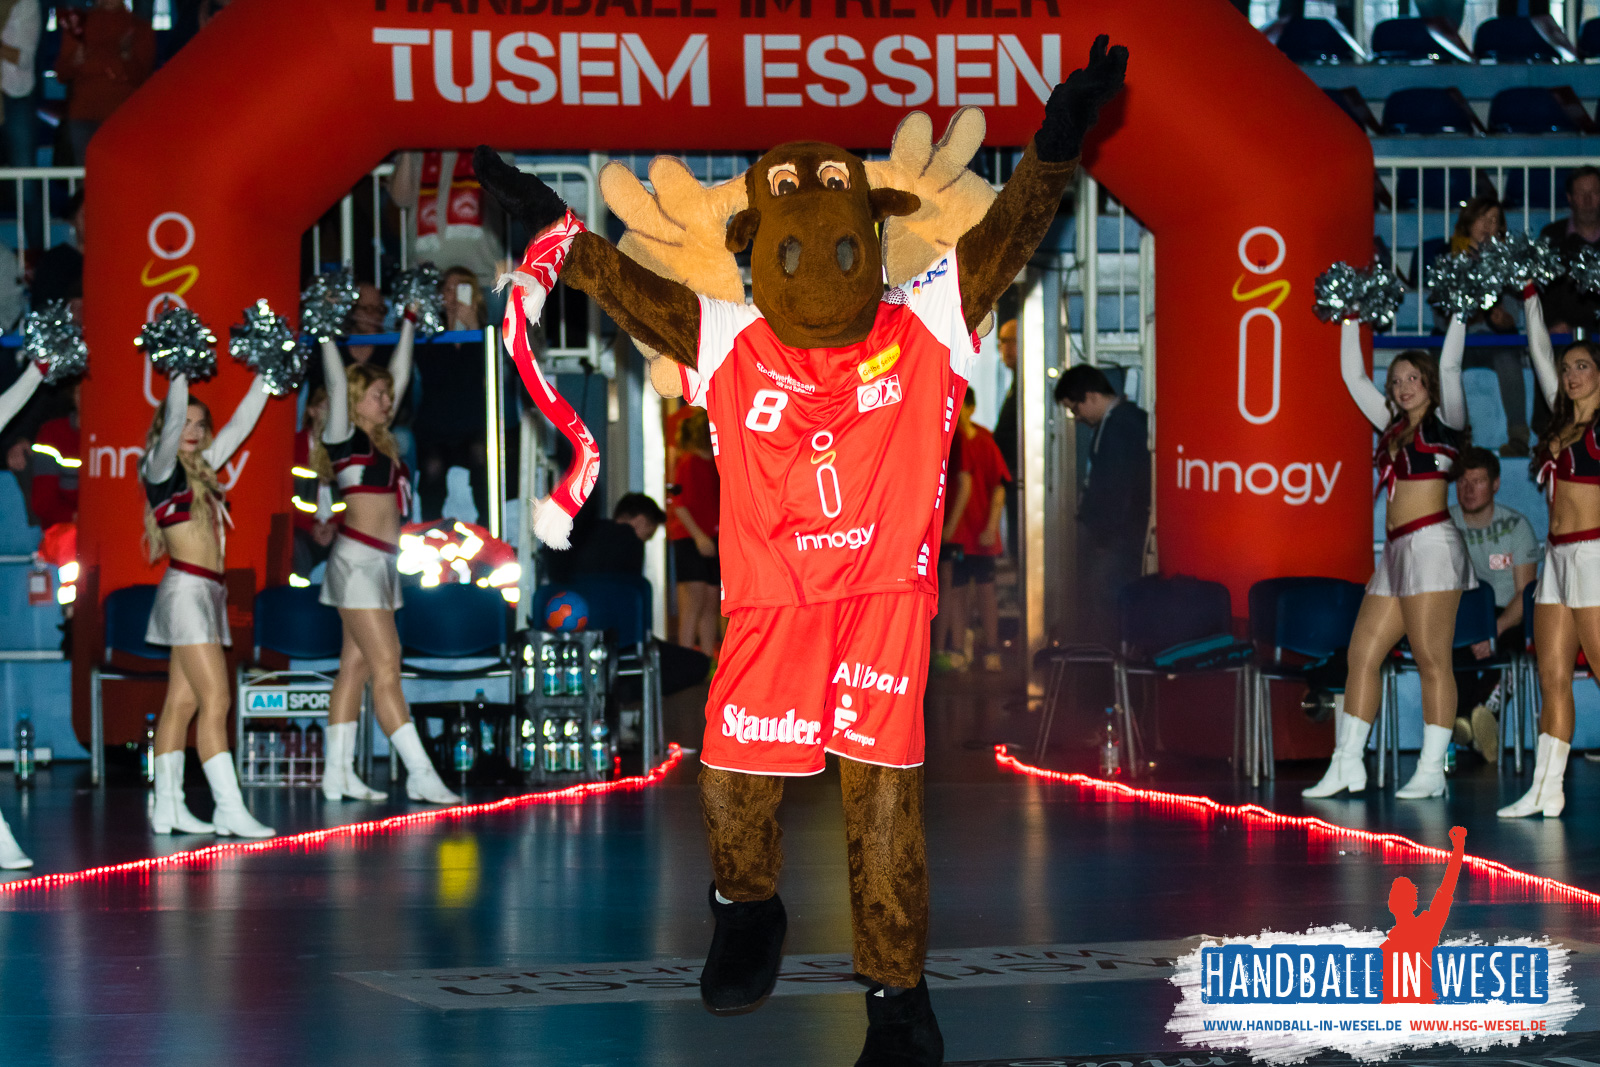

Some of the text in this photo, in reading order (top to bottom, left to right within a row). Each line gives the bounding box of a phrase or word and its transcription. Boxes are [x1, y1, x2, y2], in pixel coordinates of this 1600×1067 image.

[373, 27, 1062, 107] TUSEM ESSEN
[862, 352, 899, 376] Gelbe Seiten
[745, 388, 789, 433] 8
[89, 433, 250, 491] inny
[1177, 444, 1342, 506] innogy
[795, 522, 875, 551] innogy
[252, 692, 331, 710] AM SPOR
[844, 728, 876, 747] Kempa
